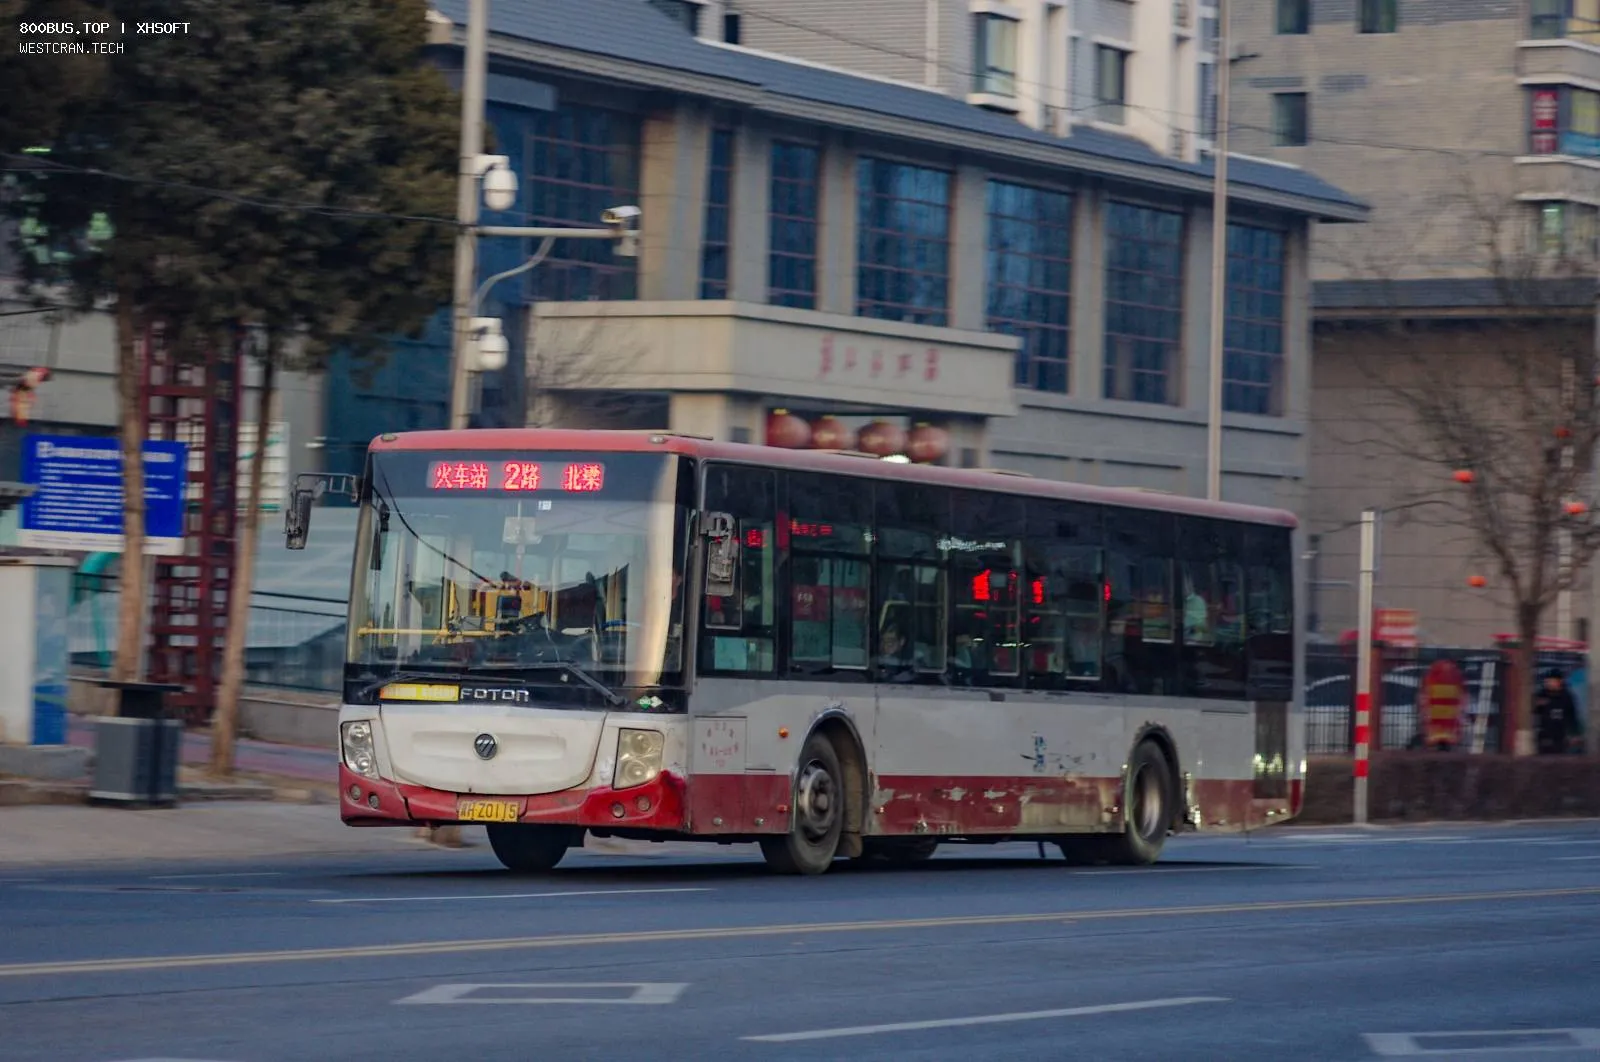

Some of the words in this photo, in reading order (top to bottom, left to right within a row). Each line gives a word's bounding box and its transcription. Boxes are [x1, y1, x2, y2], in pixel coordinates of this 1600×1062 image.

[434, 463, 489, 489] 火车站
[504, 463, 541, 490] 2路
[460, 687, 530, 702] FOTON
